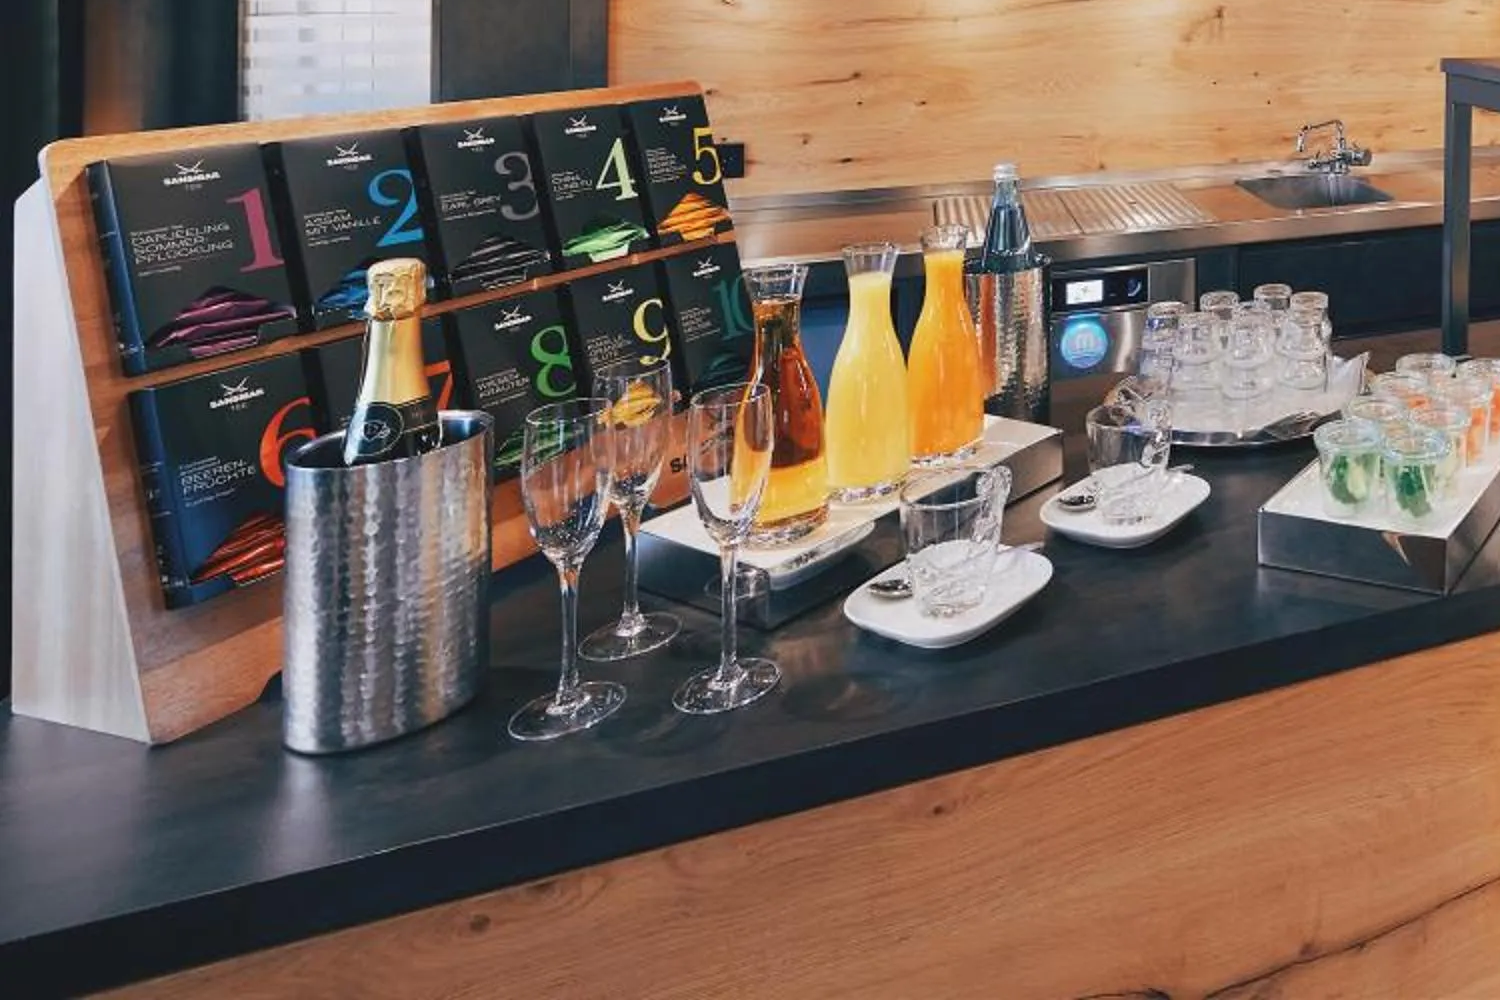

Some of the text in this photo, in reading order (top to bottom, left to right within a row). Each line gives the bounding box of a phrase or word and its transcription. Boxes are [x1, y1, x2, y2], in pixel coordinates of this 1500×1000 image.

[494, 151, 540, 221] 3
[596, 137, 639, 201] 4
[692, 127, 722, 186] 5
[226, 187, 285, 273] 1
[368, 168, 424, 247] 2
[531, 325, 578, 397] 8
[633, 298, 672, 366] 9
[260, 396, 318, 488] 6
